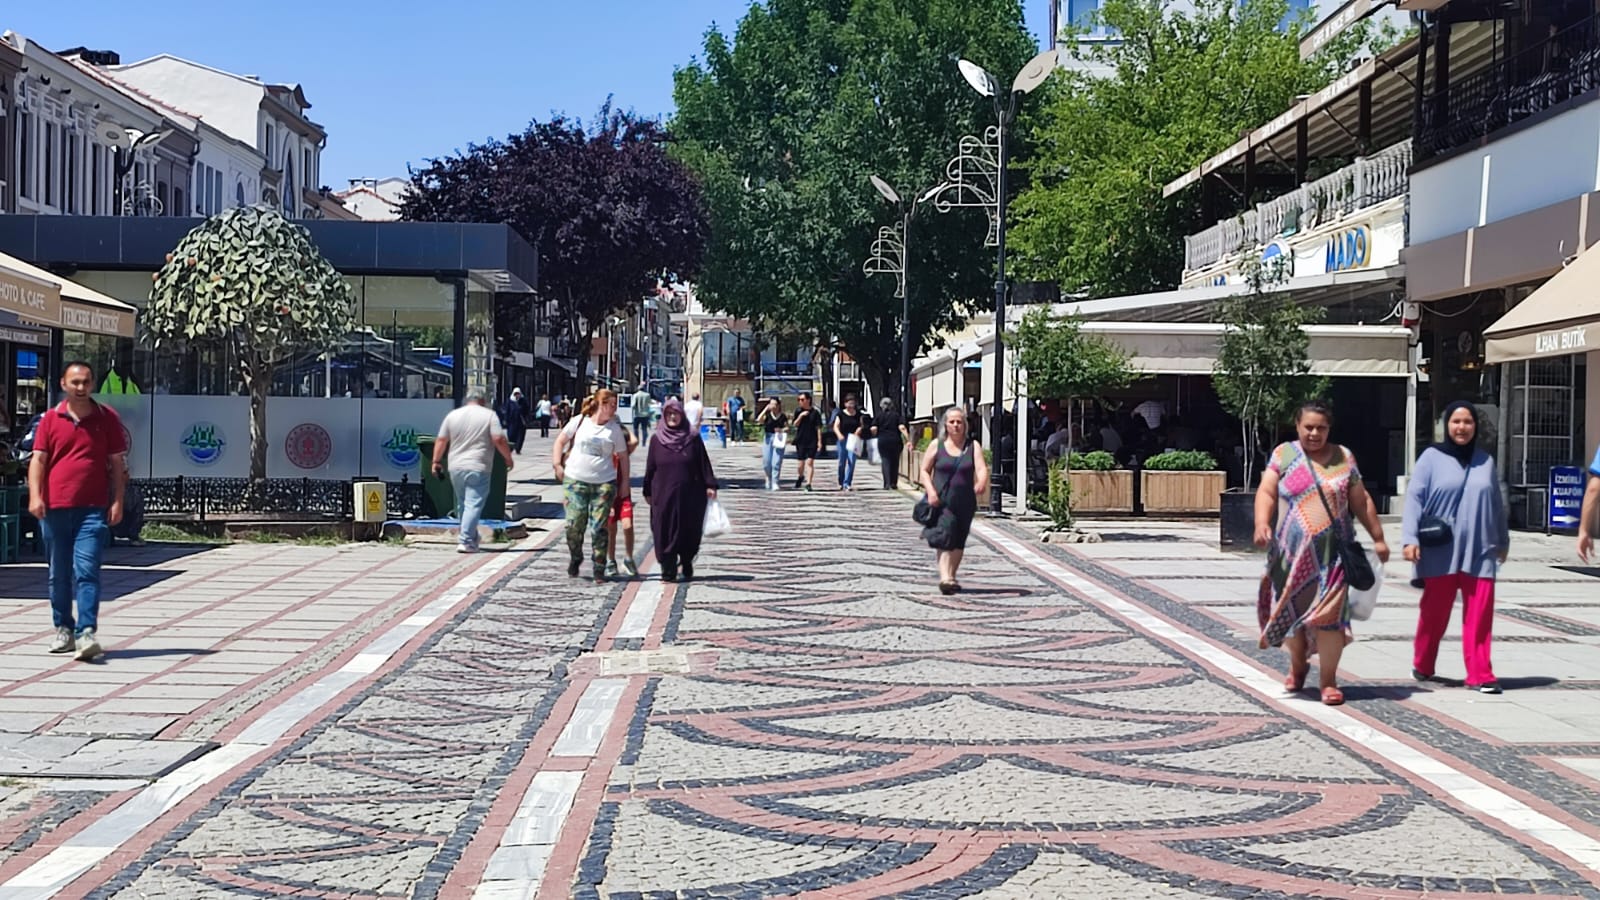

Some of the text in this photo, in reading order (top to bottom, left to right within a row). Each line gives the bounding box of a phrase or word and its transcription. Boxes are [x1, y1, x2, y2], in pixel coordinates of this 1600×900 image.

[1326, 225, 1369, 273] MADO
[20, 287, 27, 305] &
[27, 290, 46, 311] CAFE
[1561, 326, 1586, 349] BUTİK
